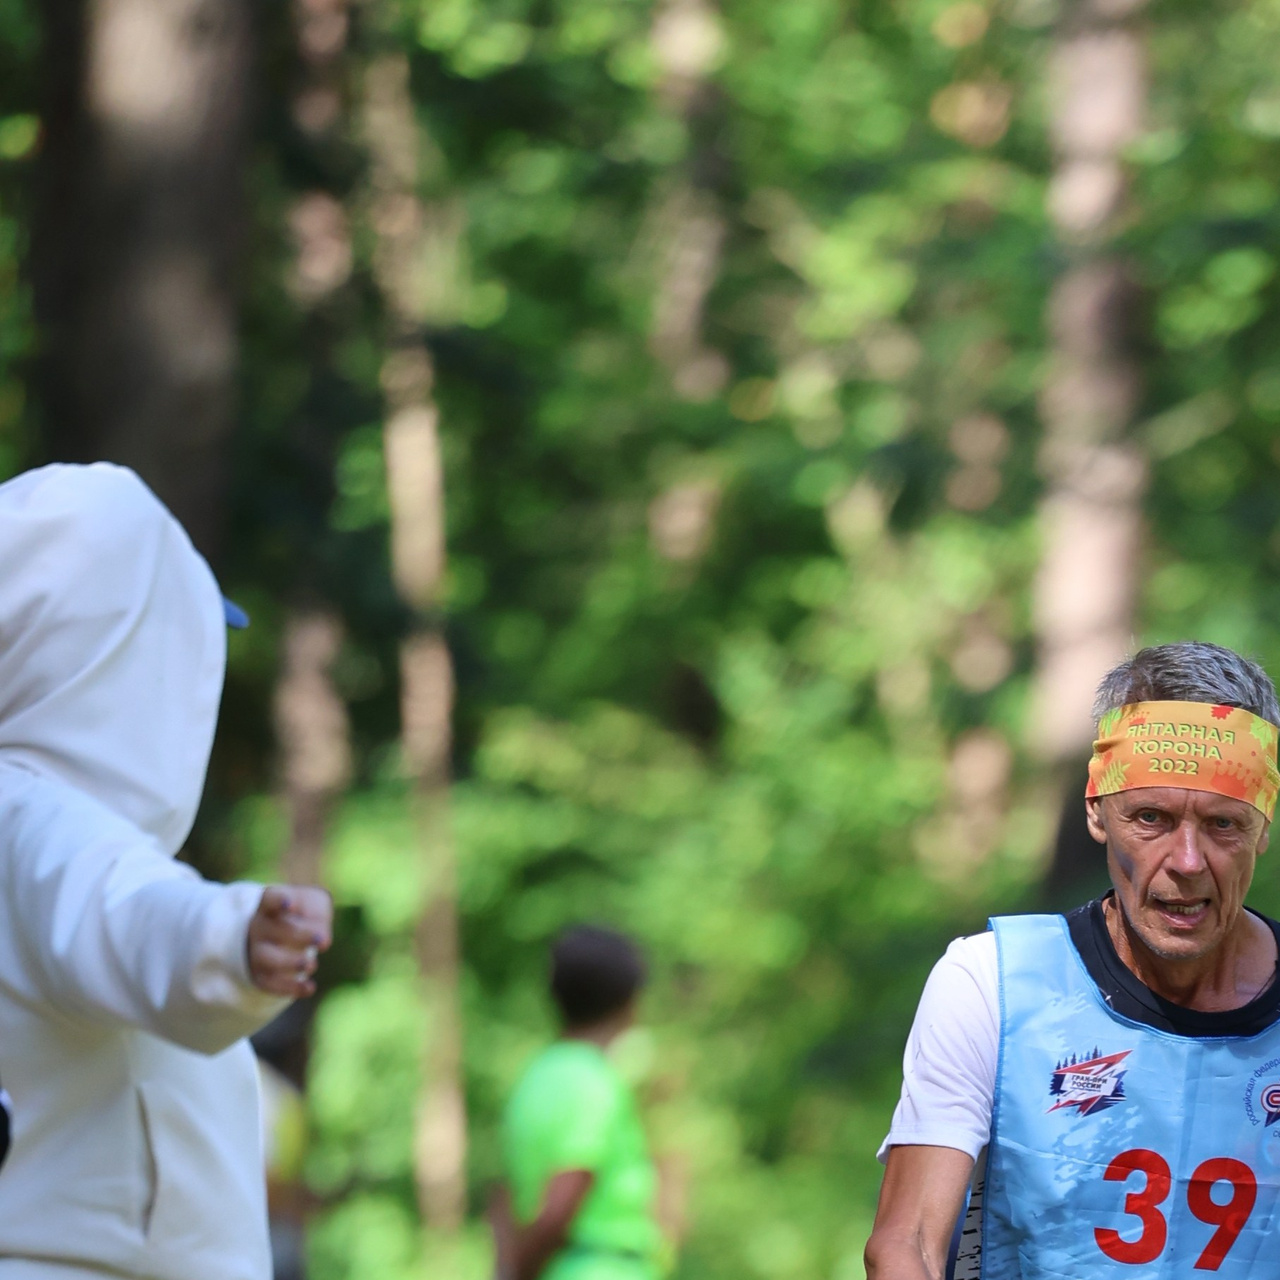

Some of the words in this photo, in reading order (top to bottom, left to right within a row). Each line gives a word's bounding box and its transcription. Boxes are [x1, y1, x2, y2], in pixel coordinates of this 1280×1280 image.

[1125, 722, 1236, 745] ЯНТАРНАЯ
[1132, 740, 1222, 760] КОРОНА
[1148, 758, 1199, 775] 2022
[1093, 1147, 1258, 1272] 39
